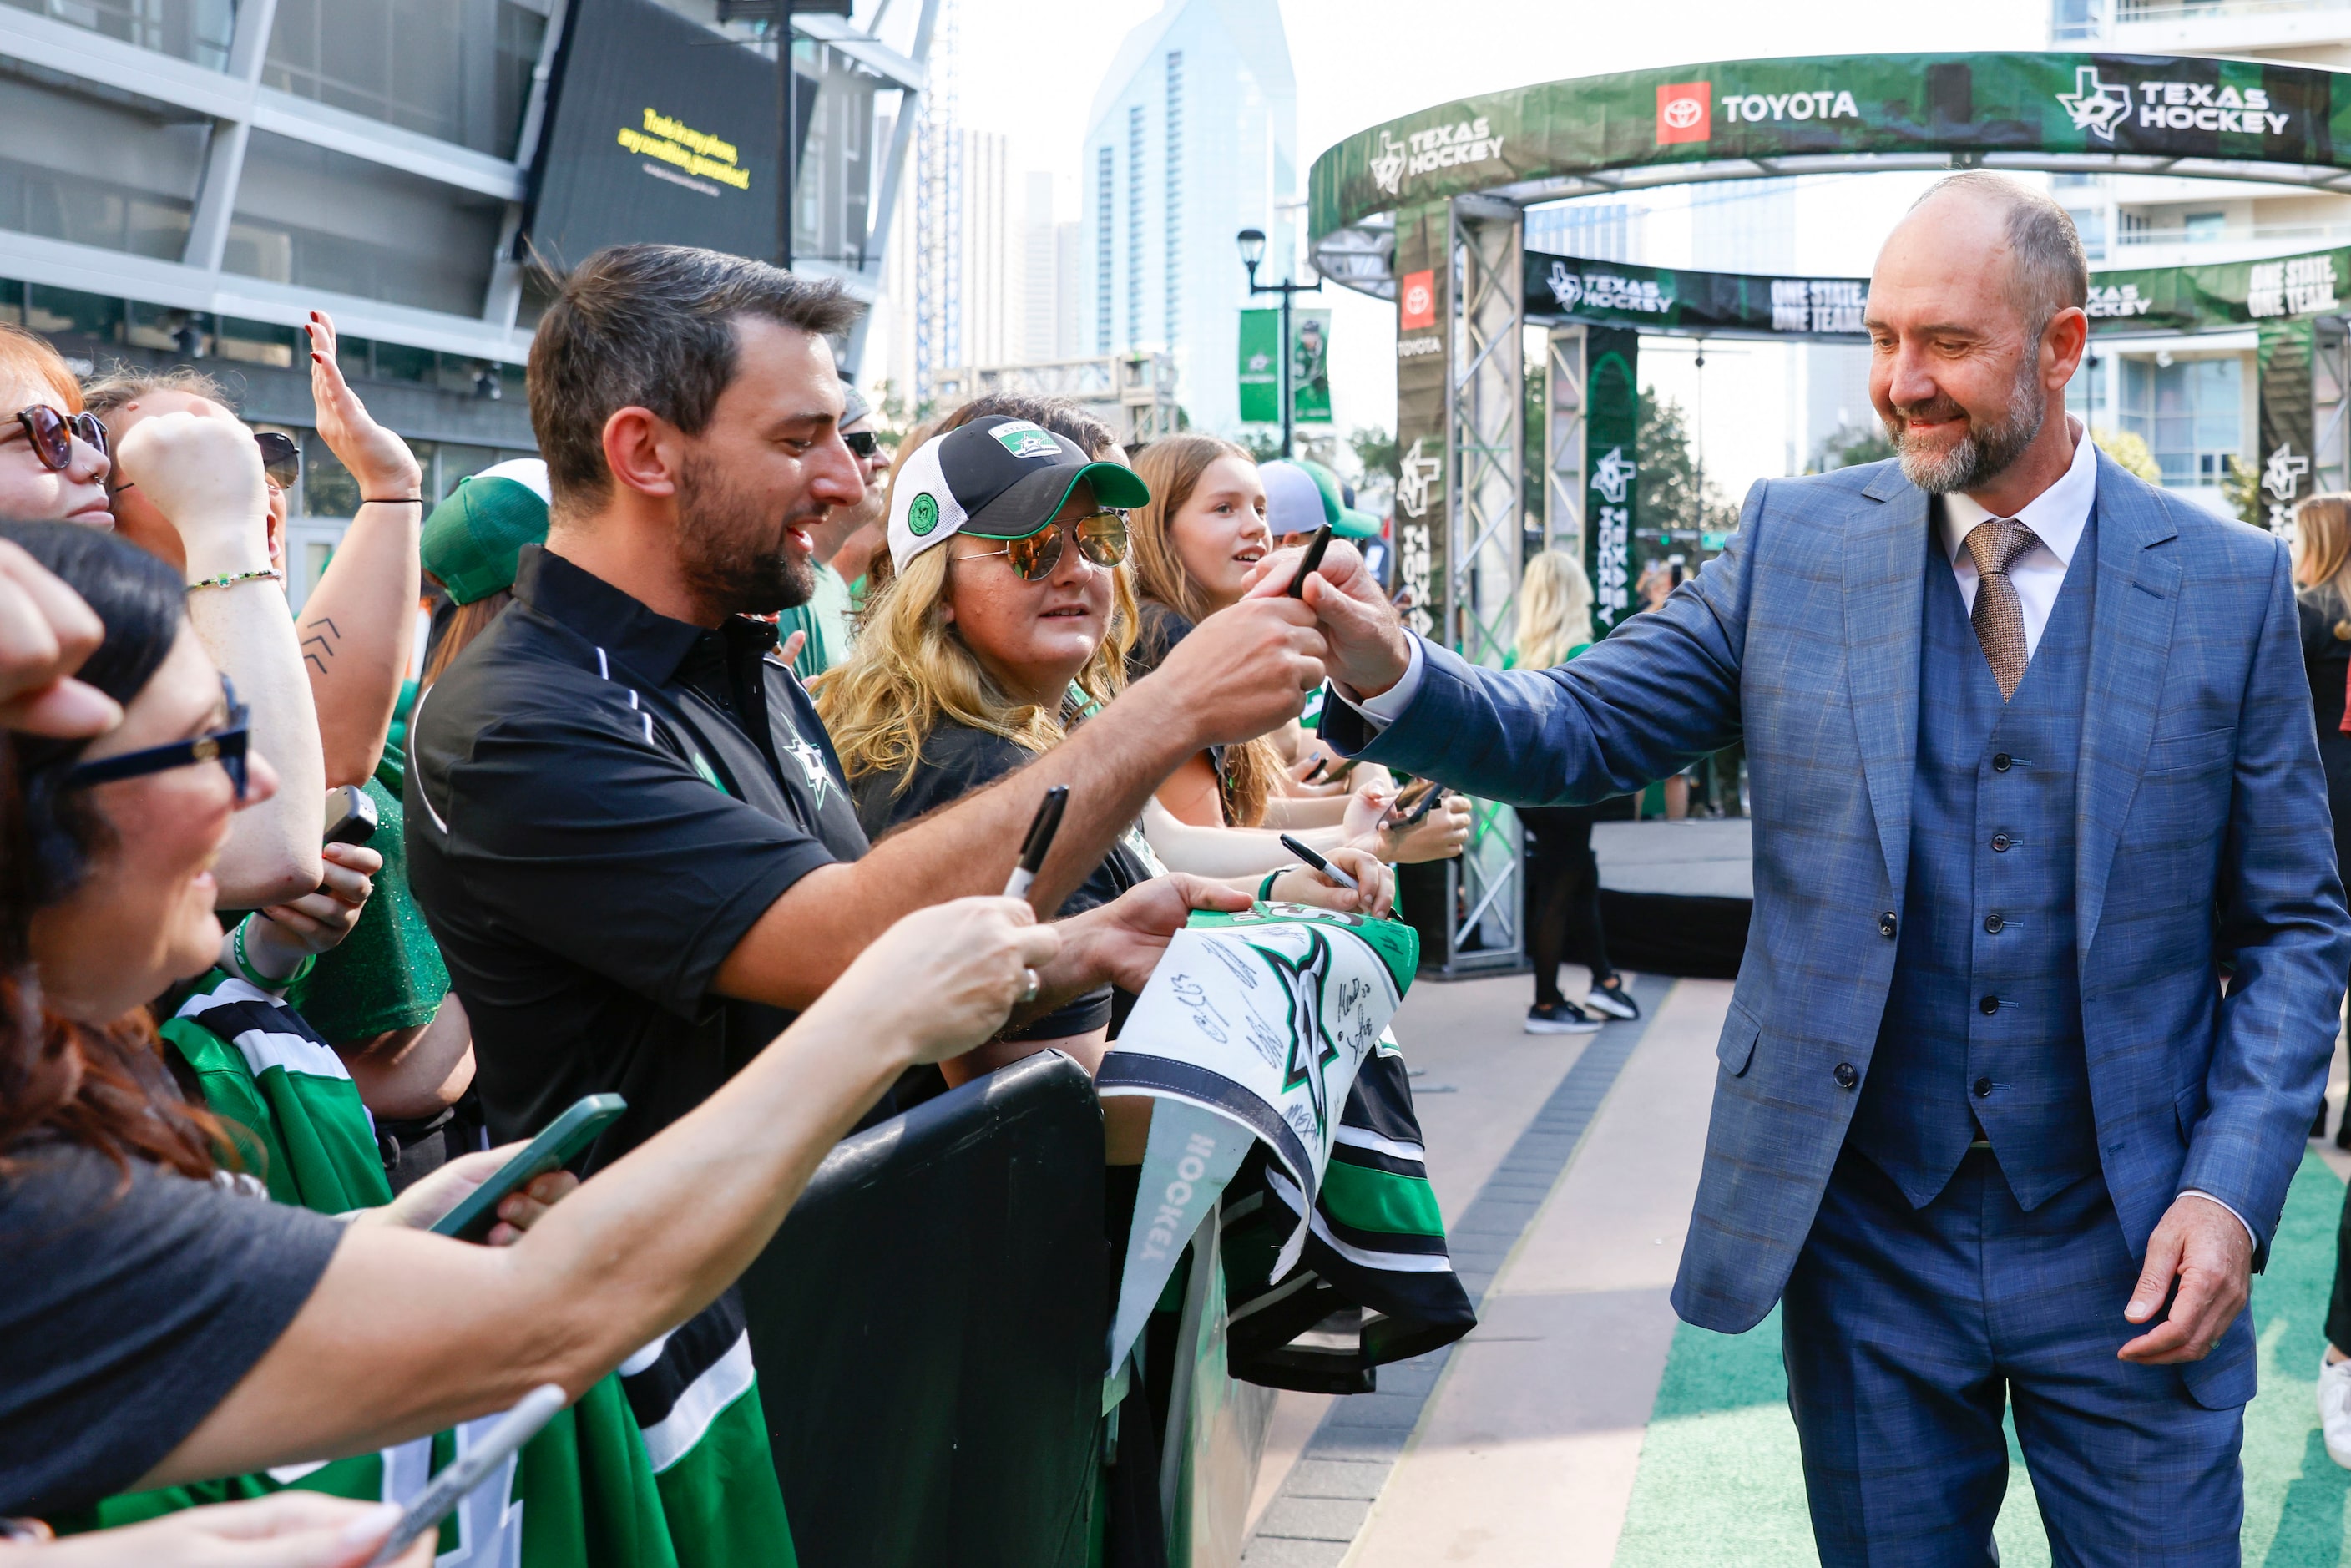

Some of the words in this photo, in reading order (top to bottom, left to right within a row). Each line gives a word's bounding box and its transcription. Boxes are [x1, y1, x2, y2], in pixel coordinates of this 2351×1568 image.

[1721, 89, 1859, 123] TOYOTA
[2138, 81, 2270, 110] TEXAS
[2139, 104, 2289, 135] HOCKEY
[1409, 116, 1491, 154] TEXAS
[1408, 135, 1504, 177] HOCKEY
[1583, 274, 1661, 298] TEXAS
[2250, 261, 2285, 291] ONE
[1582, 290, 1673, 313] HOCKEY
[1770, 279, 1808, 306] ONE
[2086, 284, 2139, 302] XAS
[2086, 298, 2152, 317] CKEY
[2247, 288, 2286, 318] ONE
[1772, 306, 1809, 331] ONE
[1398, 336, 1442, 357] TOYOTA
[1597, 506, 1615, 627] HOCKEY
[1611, 508, 1628, 610] TEXAS
[1415, 524, 1434, 639] TEXA
